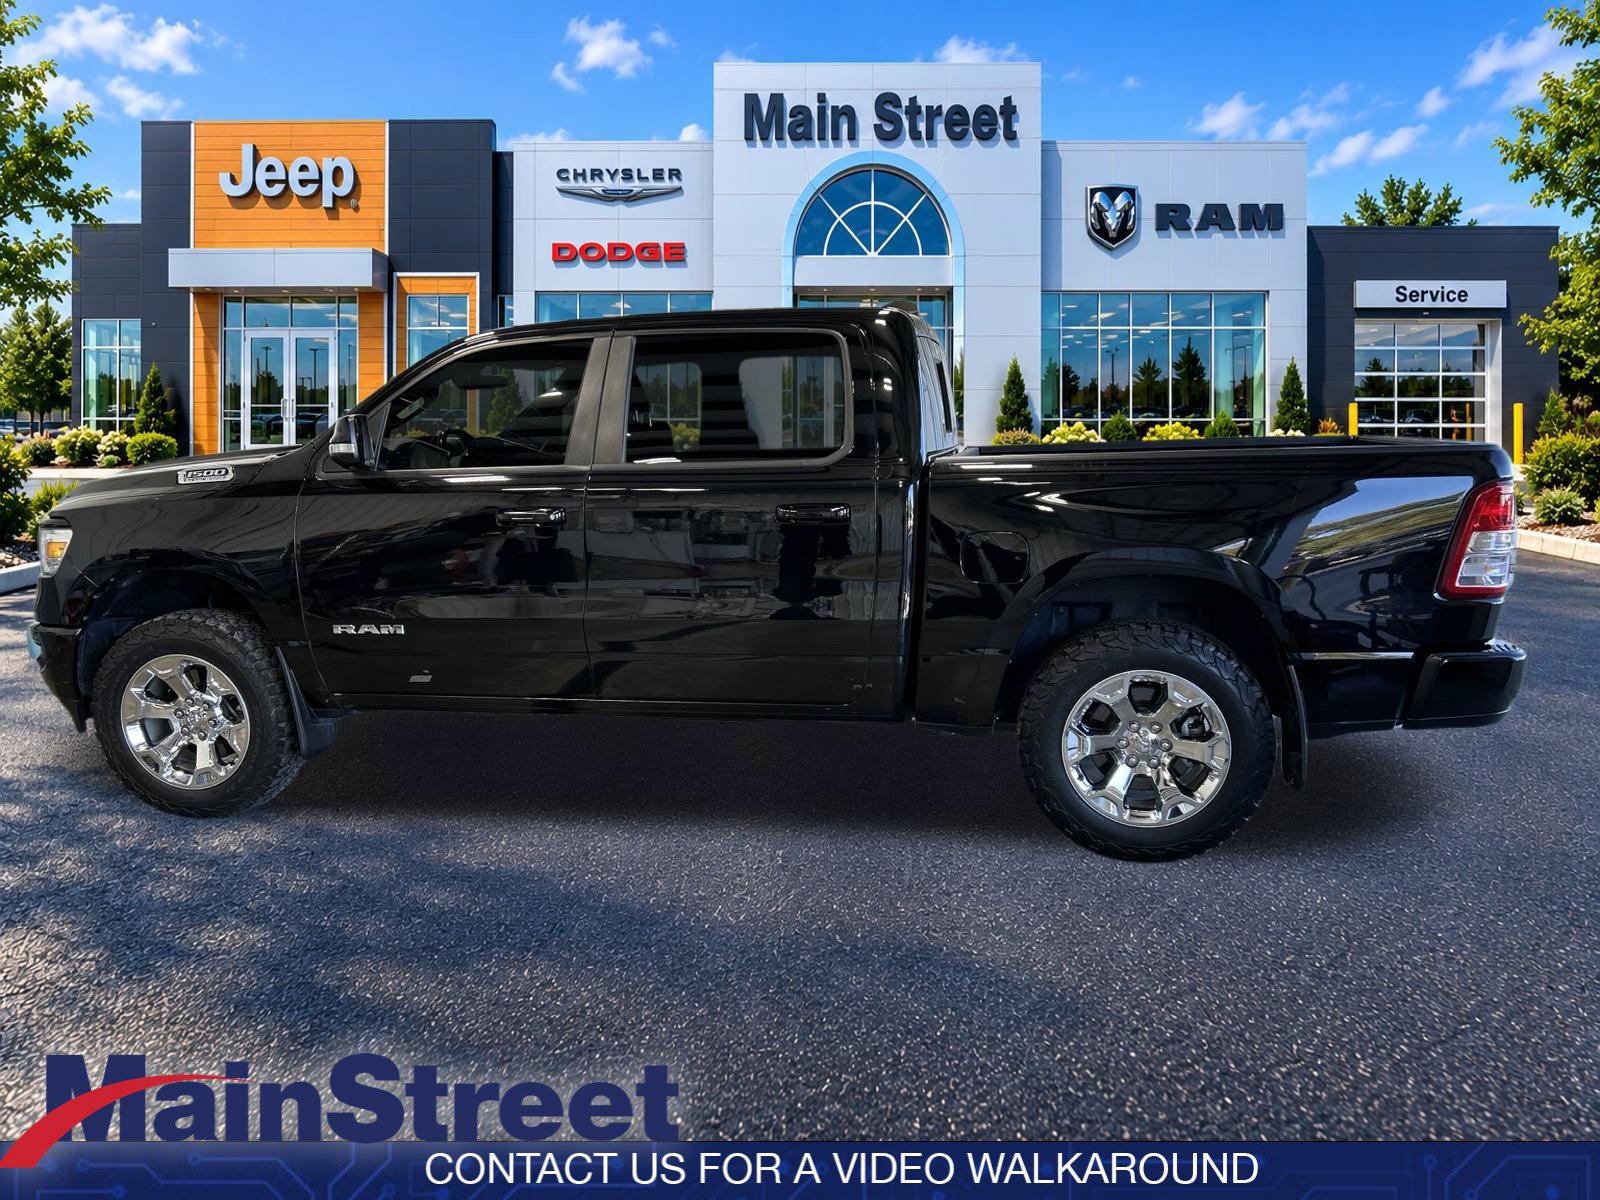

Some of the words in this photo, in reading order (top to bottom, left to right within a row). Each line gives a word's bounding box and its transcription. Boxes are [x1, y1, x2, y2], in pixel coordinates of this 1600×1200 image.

[743, 92, 857, 141] Main
[873, 91, 1017, 142] Street
[218, 143, 354, 208] Jeep
[556, 168, 683, 182] CHRYSLER
[1154, 203, 1284, 232] RAM
[551, 241, 687, 262] DODGE
[1395, 285, 1469, 303] Service
[186, 469, 227, 478] 1500
[332, 624, 405, 635] RAM
